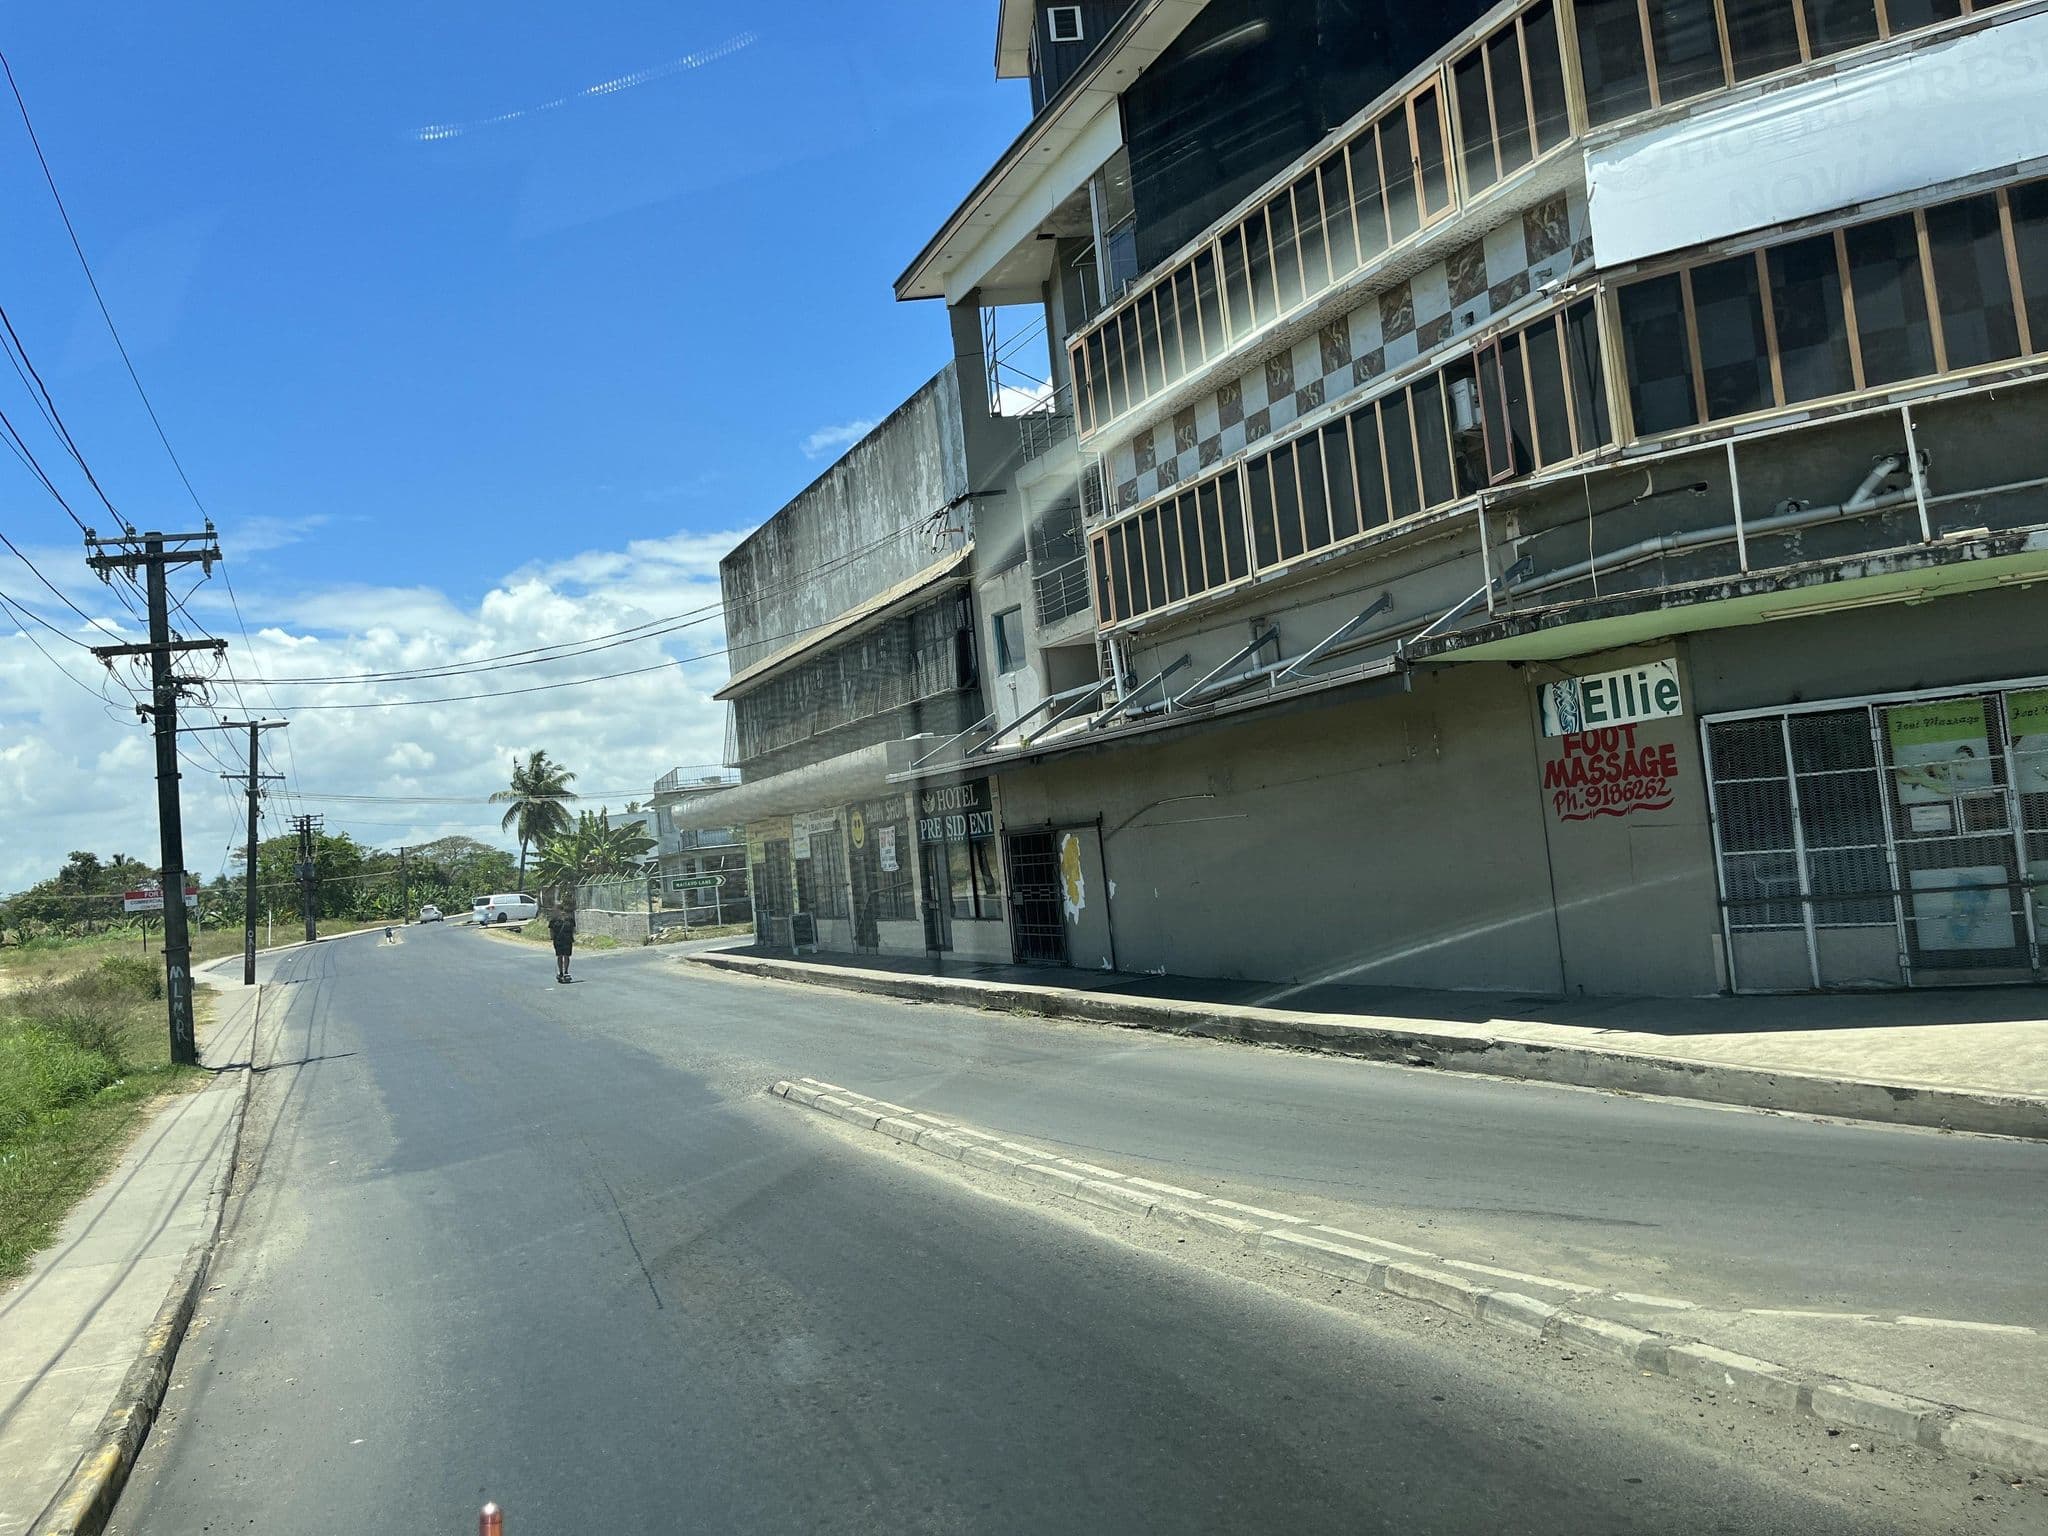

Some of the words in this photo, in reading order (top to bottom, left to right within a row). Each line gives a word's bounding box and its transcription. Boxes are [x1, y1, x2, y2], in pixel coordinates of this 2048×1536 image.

[1583, 672, 1680, 723] Ellie
[1563, 724, 1637, 758] FOOT
[1544, 744, 1678, 789] MASSAGE
[937, 785, 978, 812] HOTEL
